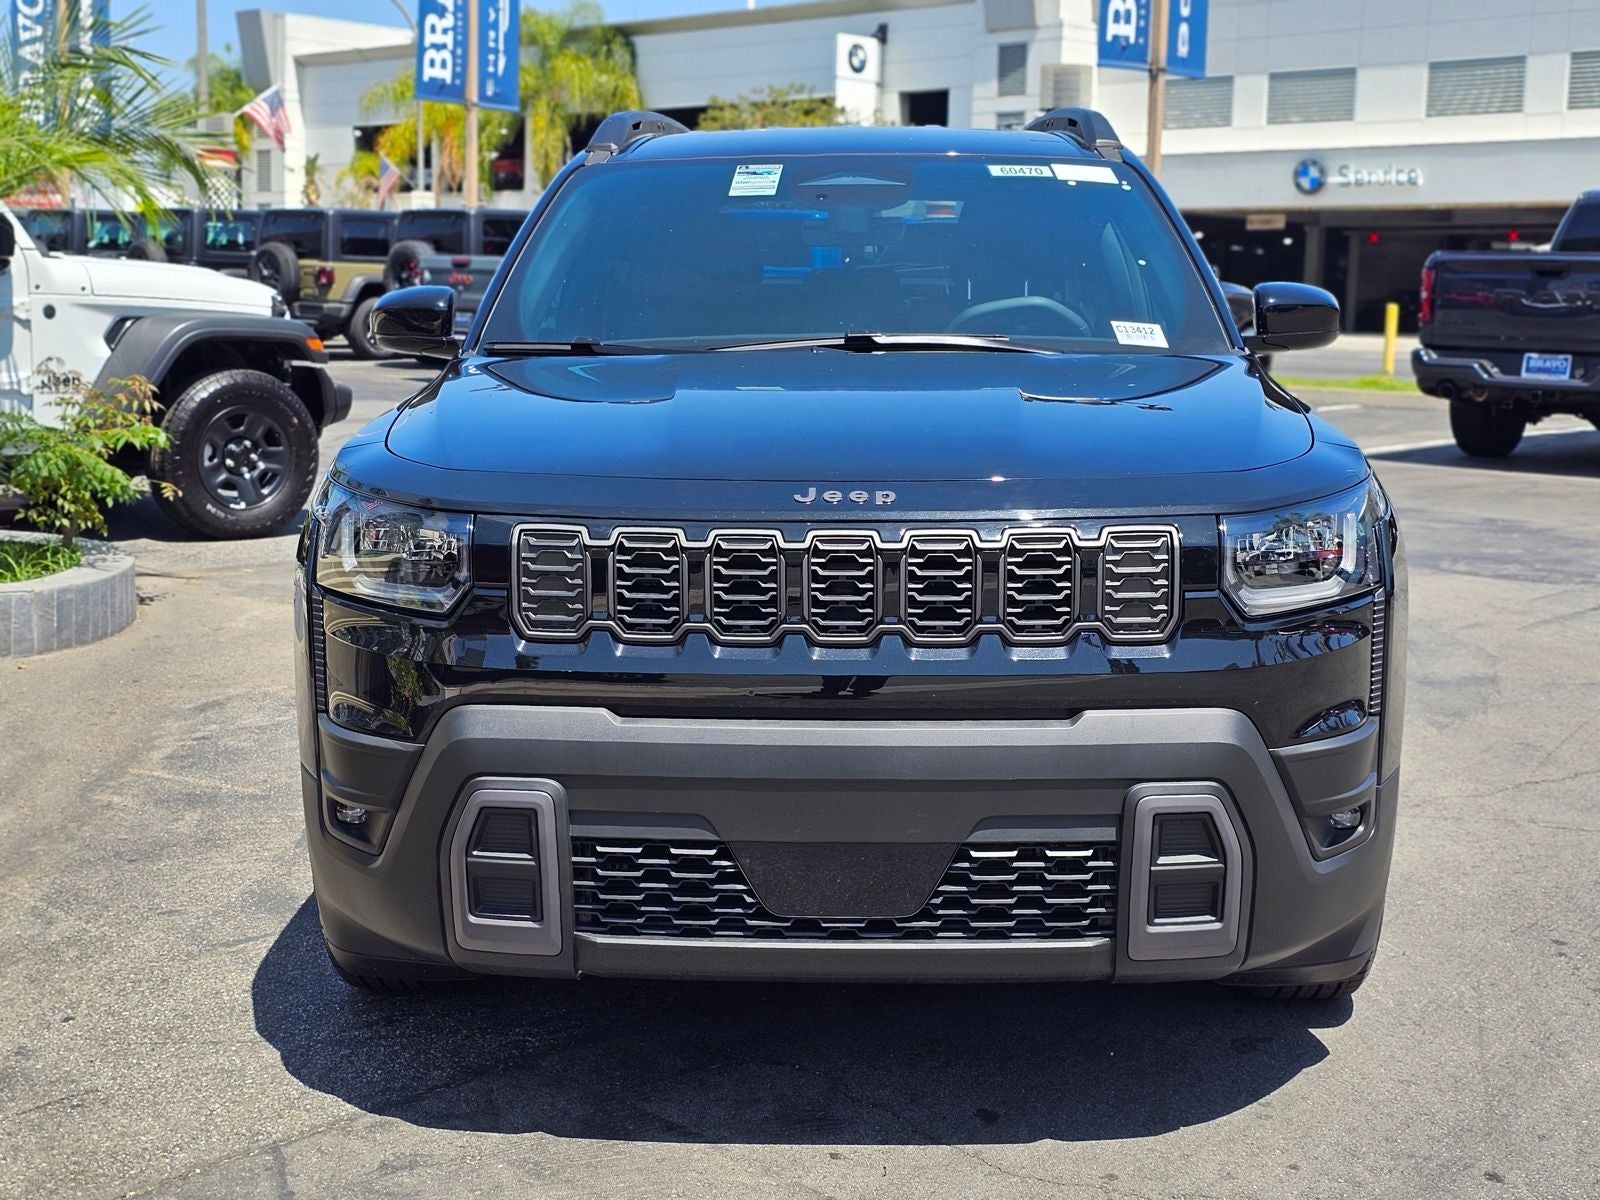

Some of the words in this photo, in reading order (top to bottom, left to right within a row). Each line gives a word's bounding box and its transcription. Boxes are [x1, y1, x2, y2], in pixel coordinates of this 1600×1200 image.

[1000, 167, 1043, 175] 60470
[1338, 163, 1421, 187] Service
[793, 487, 897, 506] Jeep
